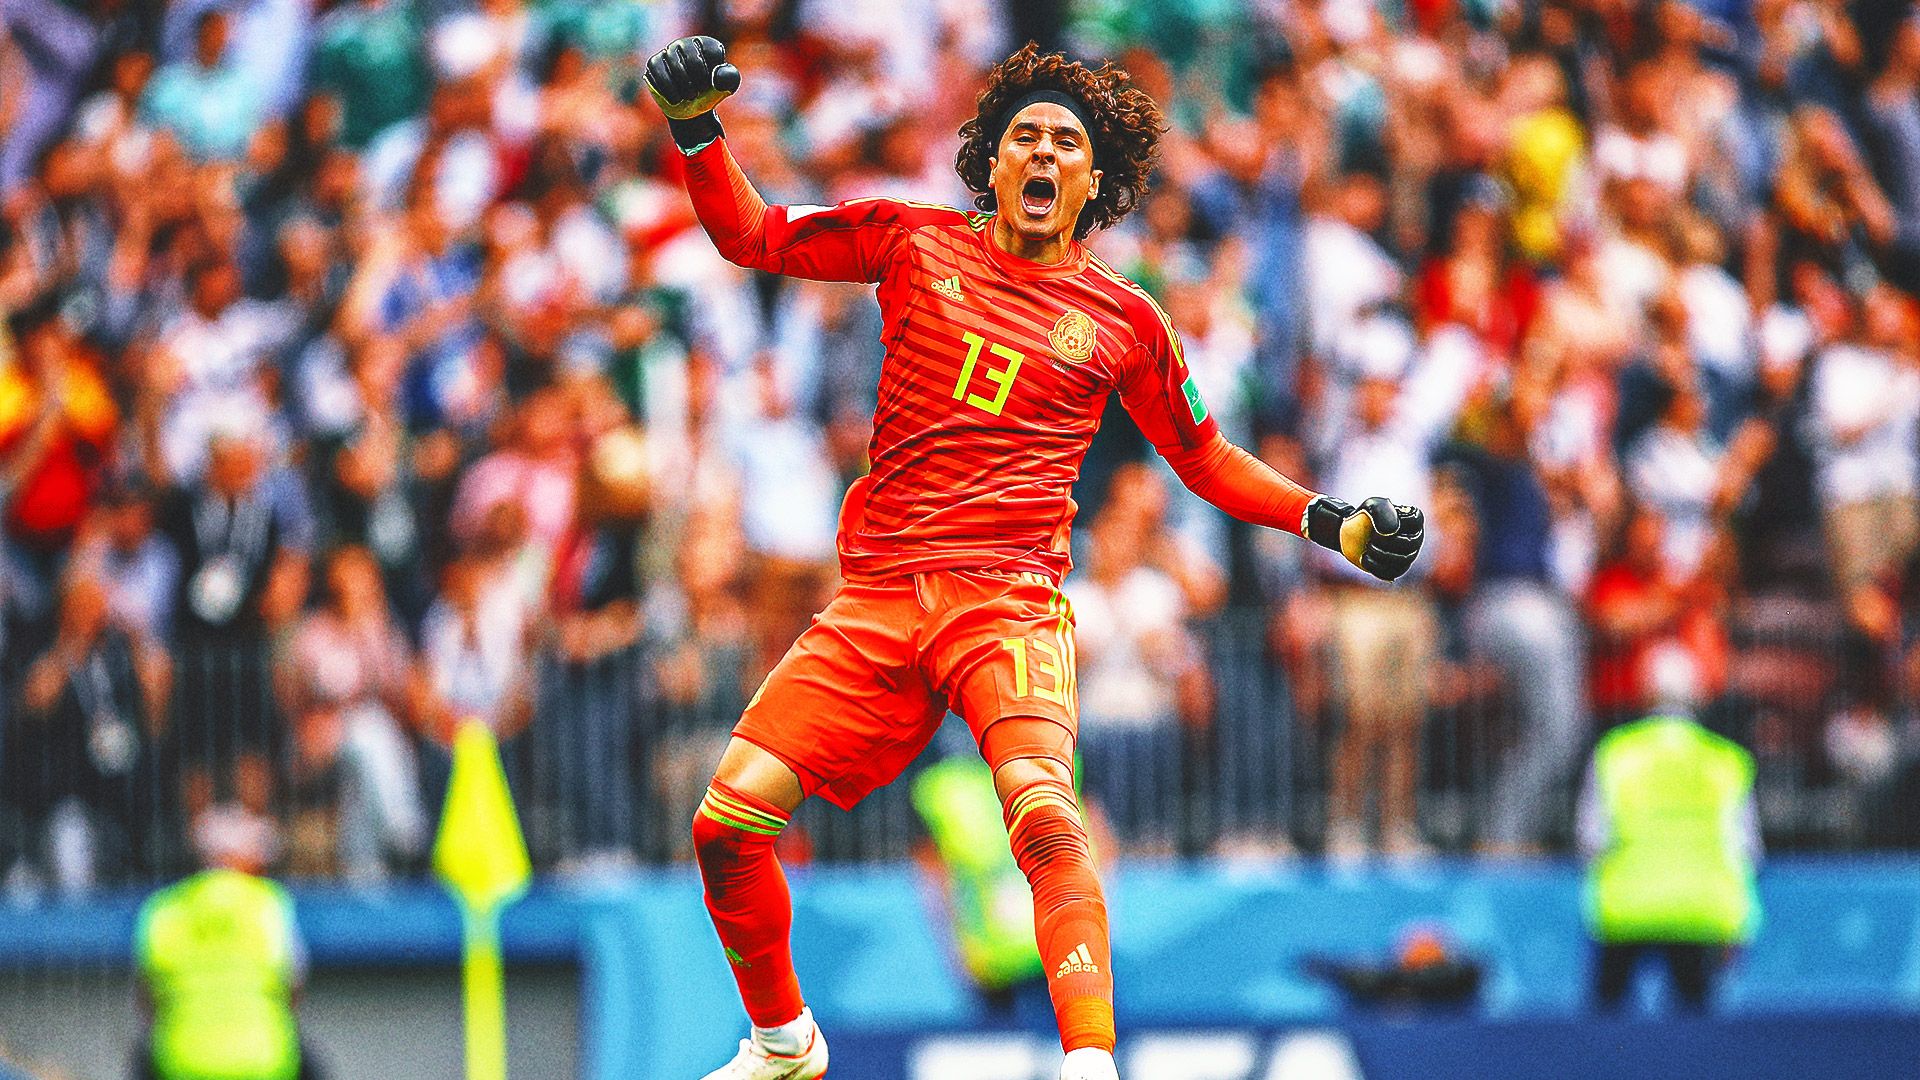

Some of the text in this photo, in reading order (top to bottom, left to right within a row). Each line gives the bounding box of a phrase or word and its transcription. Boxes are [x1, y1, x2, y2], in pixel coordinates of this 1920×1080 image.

[931, 281, 965, 302] adidas
[952, 331, 1026, 417] 13
[1002, 637, 1065, 707] 13
[1056, 961, 1099, 979] adidas
[910, 1031, 1364, 1080] FFA
